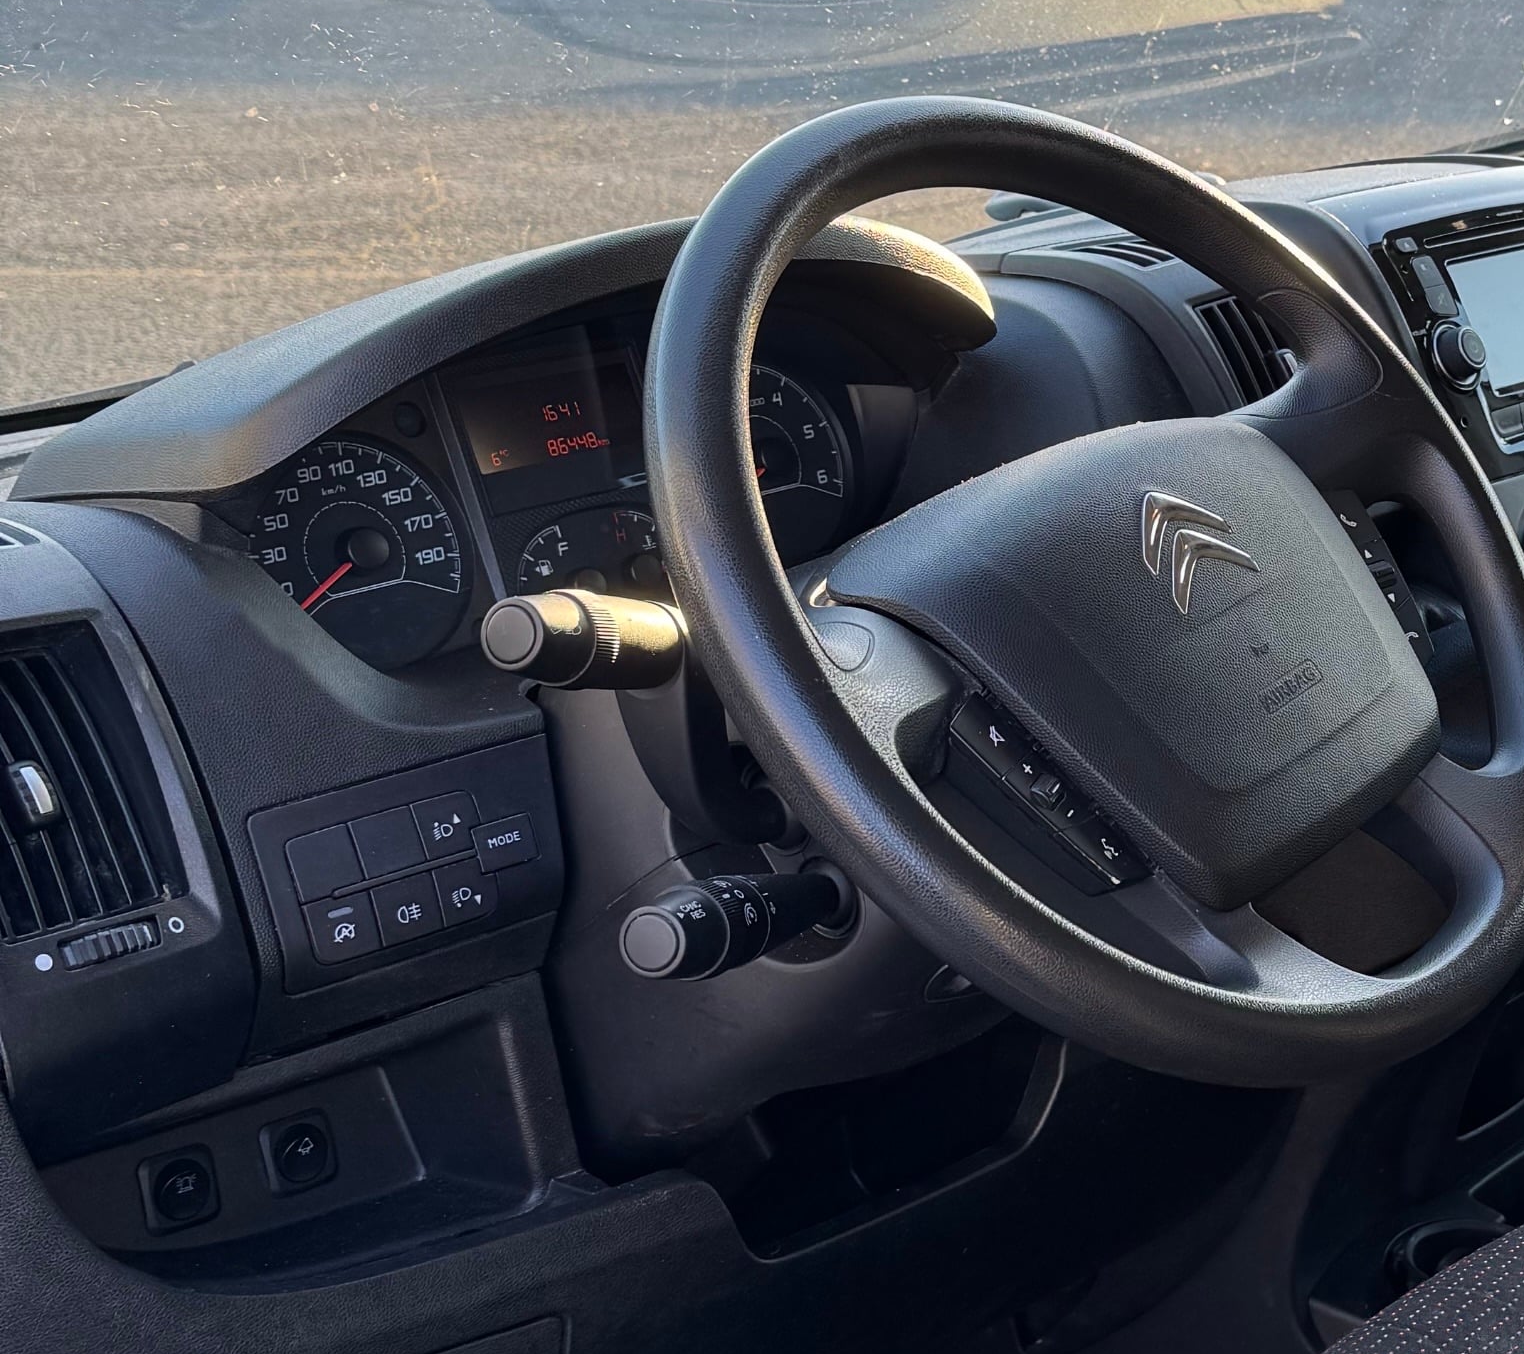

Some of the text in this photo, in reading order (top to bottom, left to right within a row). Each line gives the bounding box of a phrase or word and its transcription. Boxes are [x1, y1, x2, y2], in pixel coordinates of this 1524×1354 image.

[773, 392, 782, 405] 4
[803, 424, 815, 439] 5
[297, 465, 322, 484] 90
[328, 459, 355, 478] 110
[816, 469, 828, 485] 6
[356, 469, 387, 488] 130
[274, 487, 300, 506] 70
[321, 484, 346, 497] km/h
[381, 487, 413, 507] 150
[263, 513, 289, 532] 50
[404, 514, 433, 533] 170
[261, 546, 288, 565] 30
[415, 546, 446, 566] 190
[558, 542, 568, 556] F
[1261, 665, 1319, 715] AIRBAG
[487, 830, 521, 849] MODE
